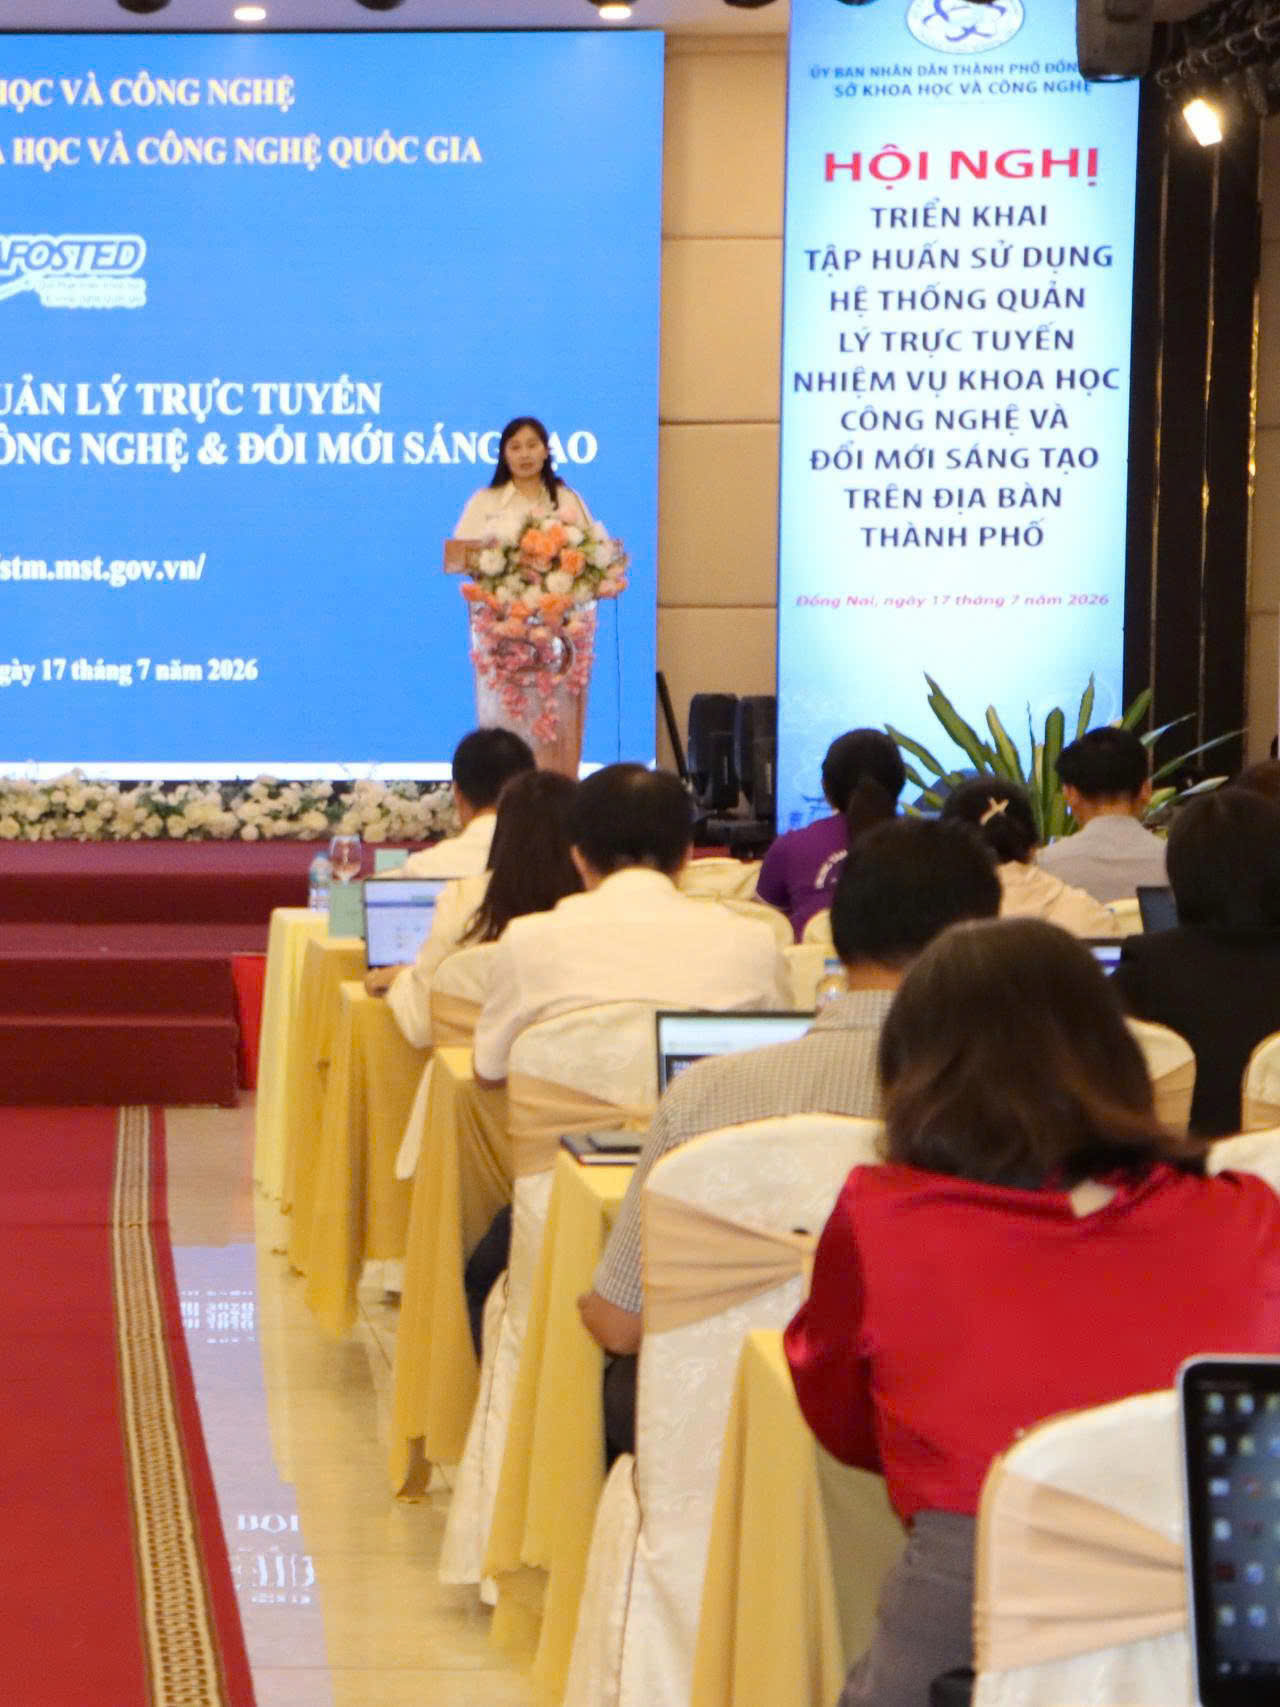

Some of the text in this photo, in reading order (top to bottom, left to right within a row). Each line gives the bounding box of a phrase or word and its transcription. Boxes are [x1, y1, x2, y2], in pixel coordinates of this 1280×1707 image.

[1045, 59, 1078, 74] ĐỒN
[60, 71, 103, 106] VÀ
[109, 70, 201, 107] CÔNG
[207, 75, 295, 113] NGHỆ
[863, 83, 912, 97] KHOA
[988, 79, 1037, 95] CÔNG
[13, 137, 81, 172] HỌC
[87, 129, 131, 165] VÀ
[136, 128, 227, 165] CÔNG
[234, 132, 322, 171] NGHỆ
[328, 129, 419, 169] QUỐC
[425, 136, 483, 164] GIA
[825, 144, 1099, 190] HỘI NGHỊ
[871, 197, 1047, 228] TRIỂN KHAI
[805, 240, 1113, 278] TẬP HUẤN SỬ DỤNG
[830, 280, 1085, 317] HỆ THỐNG QUẢN
[839, 322, 1074, 358] LÝ TRỰC TUYẾN
[76, 373, 128, 416] LÝ
[135, 377, 244, 424] TRỰC
[252, 373, 382, 416] TUYẾN
[794, 366, 1120, 398] NHIỆM VỤ KHOA HỌC
[841, 403, 1069, 436] CÔNG NGHỆ VÀ
[80, 427, 189, 473] NGHỆ
[197, 432, 229, 465] &
[238, 423, 308, 465] ĐỔI
[317, 422, 394, 465] MỚI
[548, 432, 598, 471] ẠO
[810, 439, 1099, 475] ĐỔI MỚI SÁNG TẠO
[844, 482, 1062, 515] TRÊN ĐỊA BÀN
[860, 518, 1044, 548] THÀNH PHỐ
[42, 658, 66, 681] 17
[71, 658, 132, 687] tháng
[137, 658, 150, 681] 7
[156, 658, 202, 681] năm
[208, 658, 258, 681] 2026
